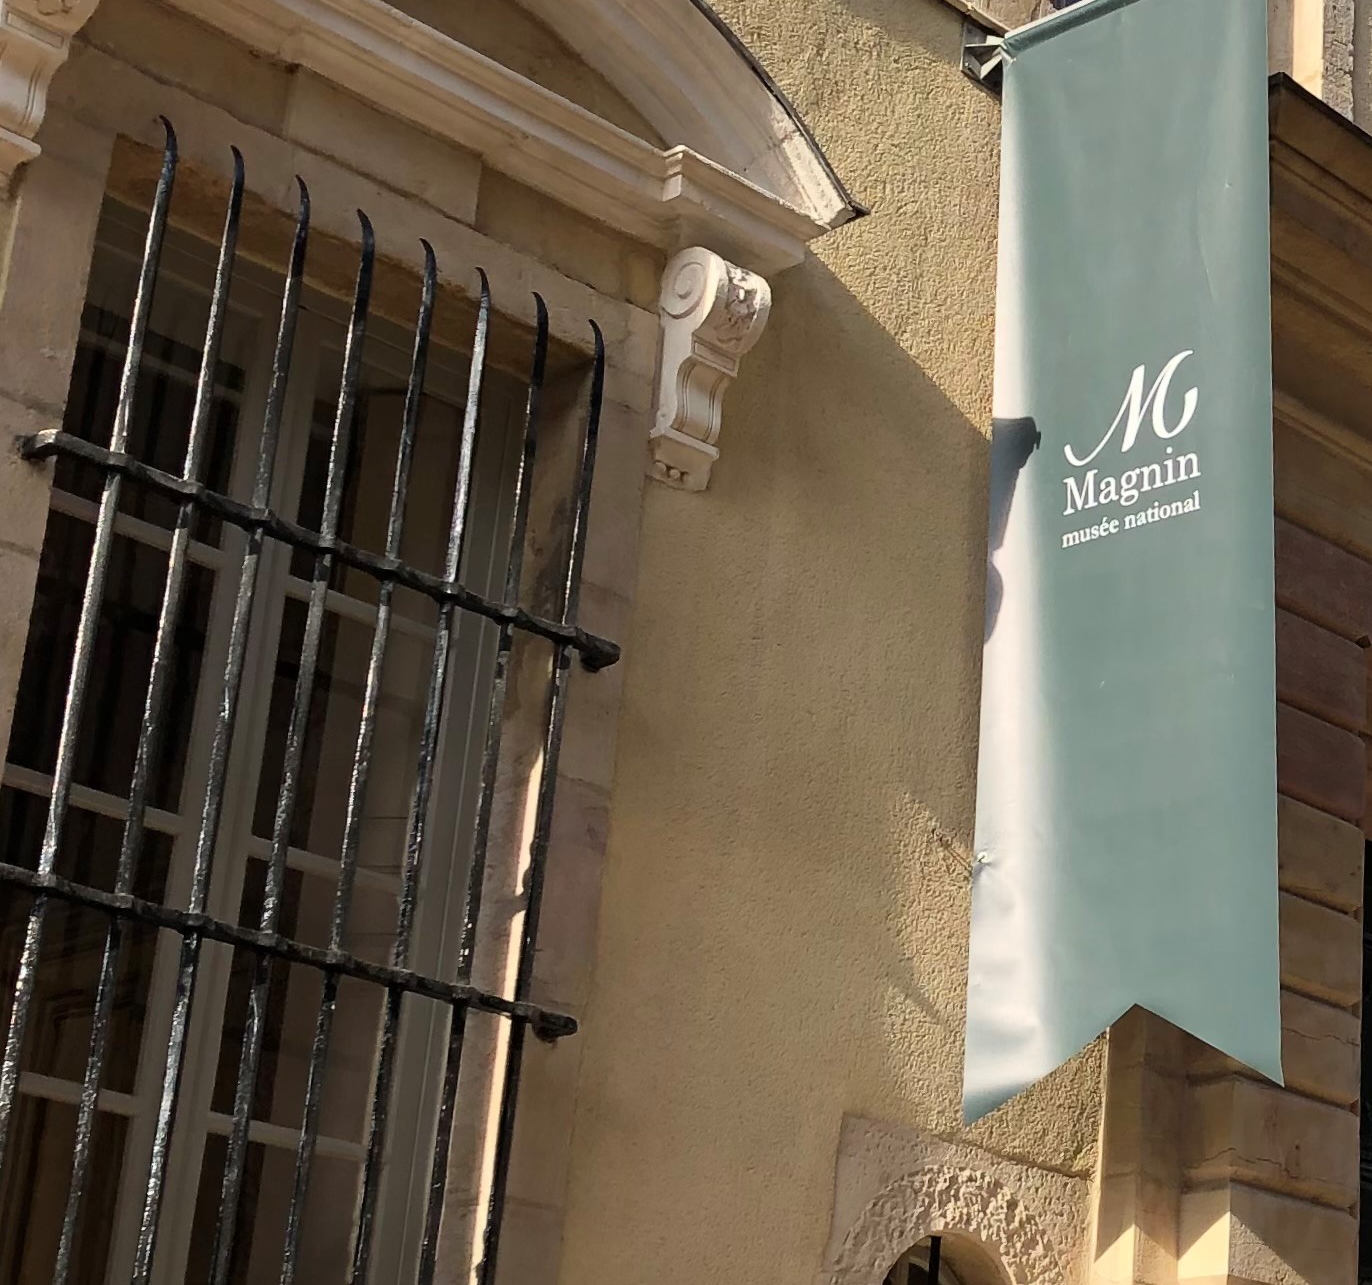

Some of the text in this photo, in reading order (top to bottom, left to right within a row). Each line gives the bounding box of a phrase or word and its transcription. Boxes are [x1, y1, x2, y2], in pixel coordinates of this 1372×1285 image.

[1062, 446, 1202, 516] Magnin
[1061, 490, 1201, 549] musée national
